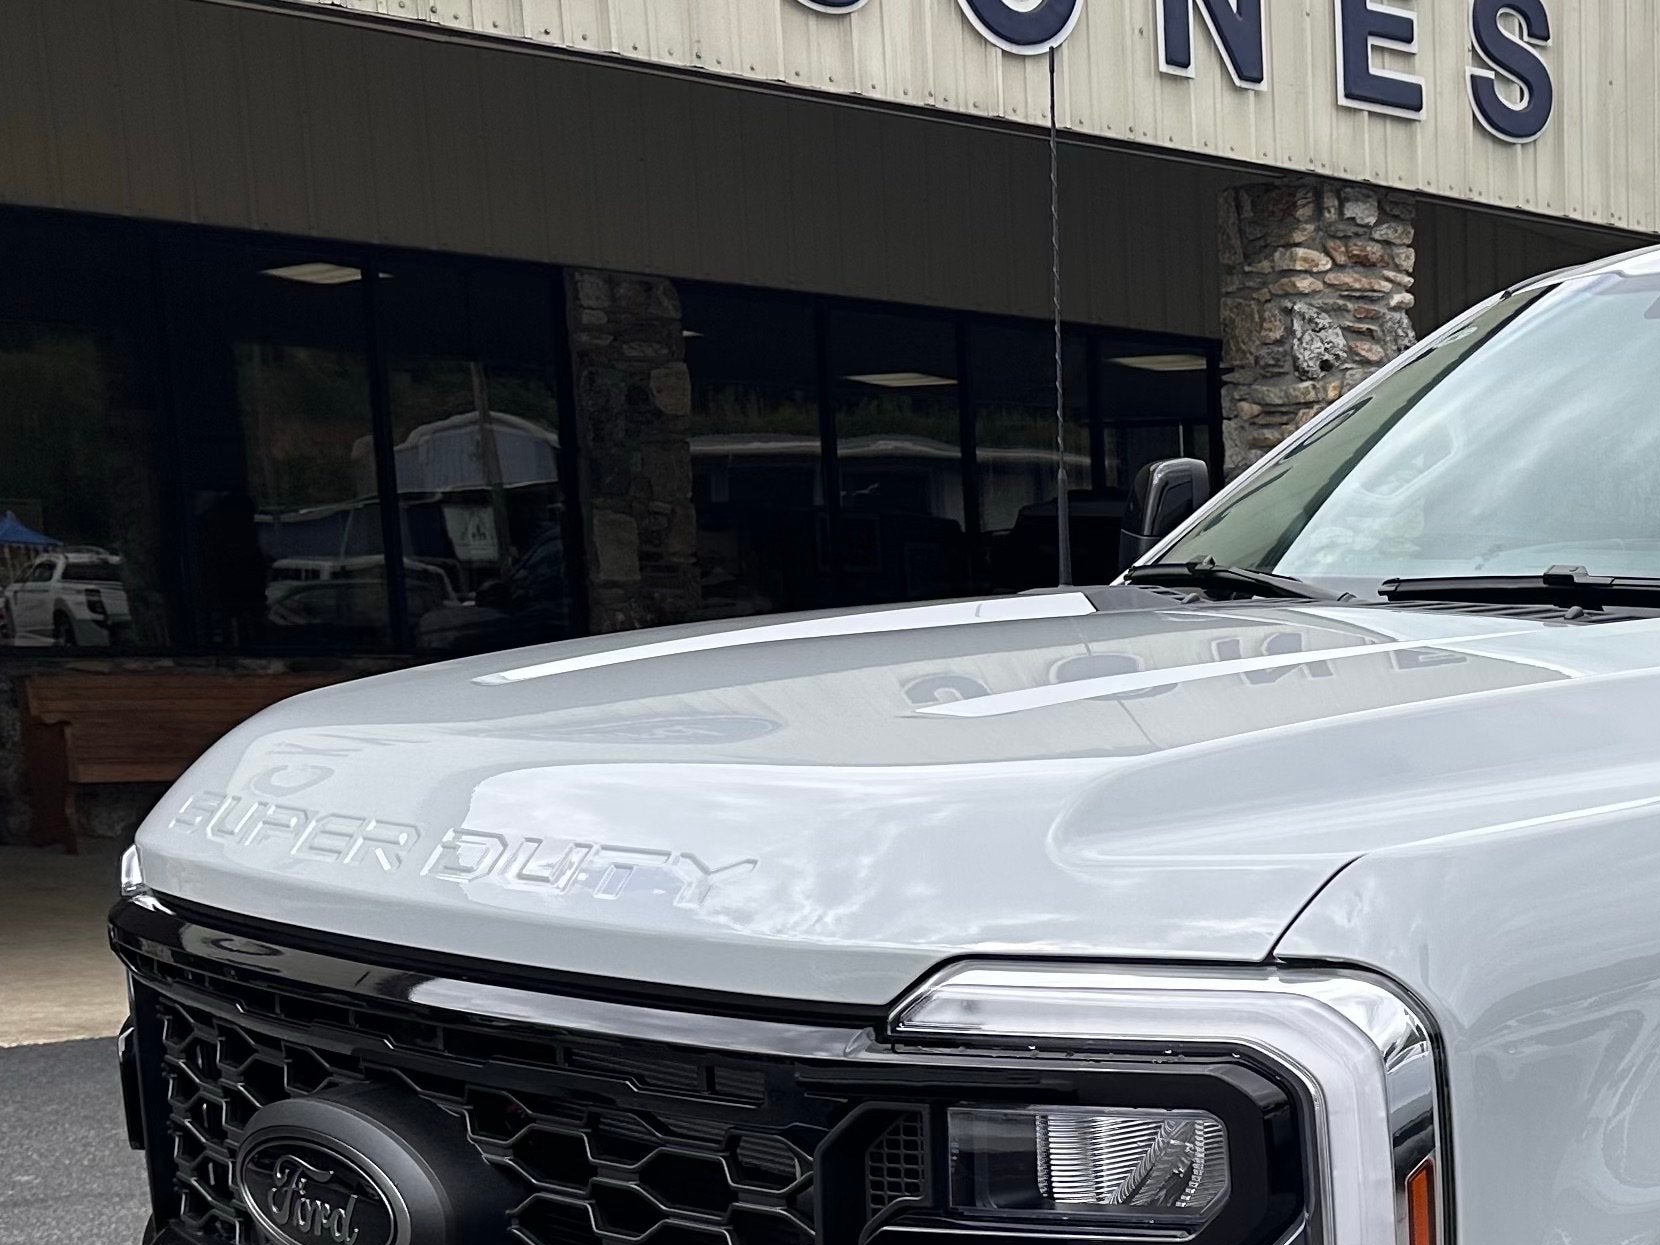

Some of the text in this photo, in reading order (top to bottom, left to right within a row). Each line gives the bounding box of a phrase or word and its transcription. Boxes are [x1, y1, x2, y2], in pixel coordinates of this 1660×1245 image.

[797, 0, 1555, 145] NES
[169, 790, 758, 909] SUPER DUTY
[268, 1154, 359, 1245] Ford
